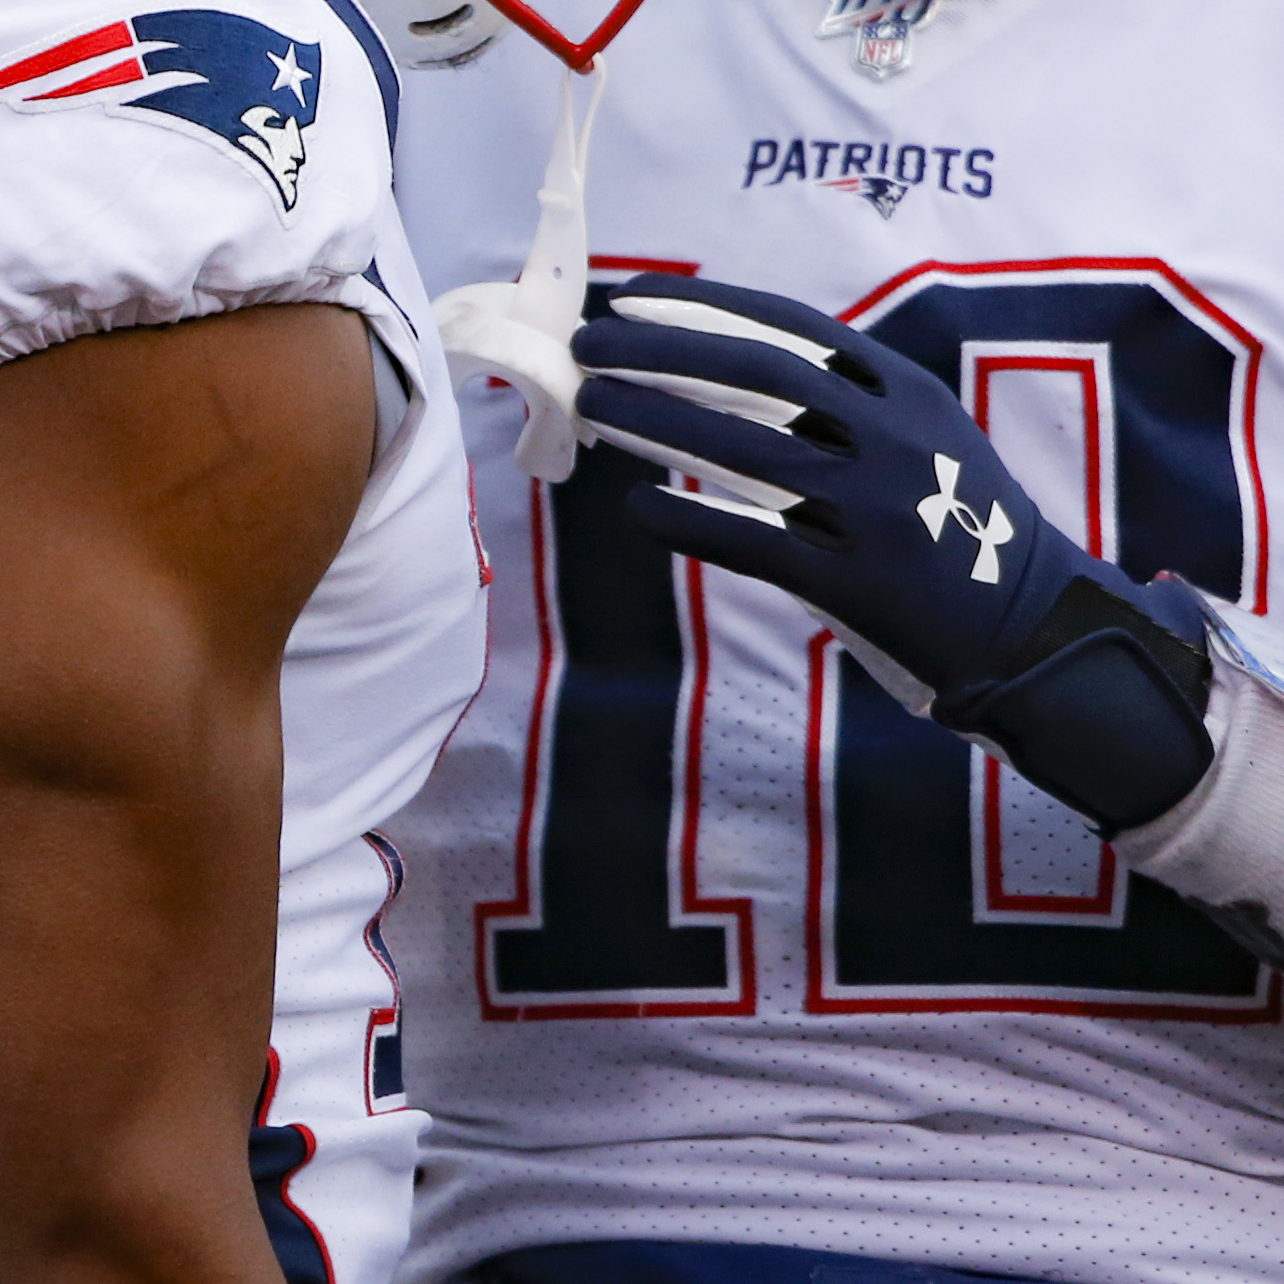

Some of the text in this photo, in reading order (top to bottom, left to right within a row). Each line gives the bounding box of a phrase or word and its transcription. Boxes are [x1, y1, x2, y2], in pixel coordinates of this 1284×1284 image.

[864, 39, 901, 63] NFL
[741, 138, 995, 199] PATRIOTS
[474, 254, 1282, 1024] 12
